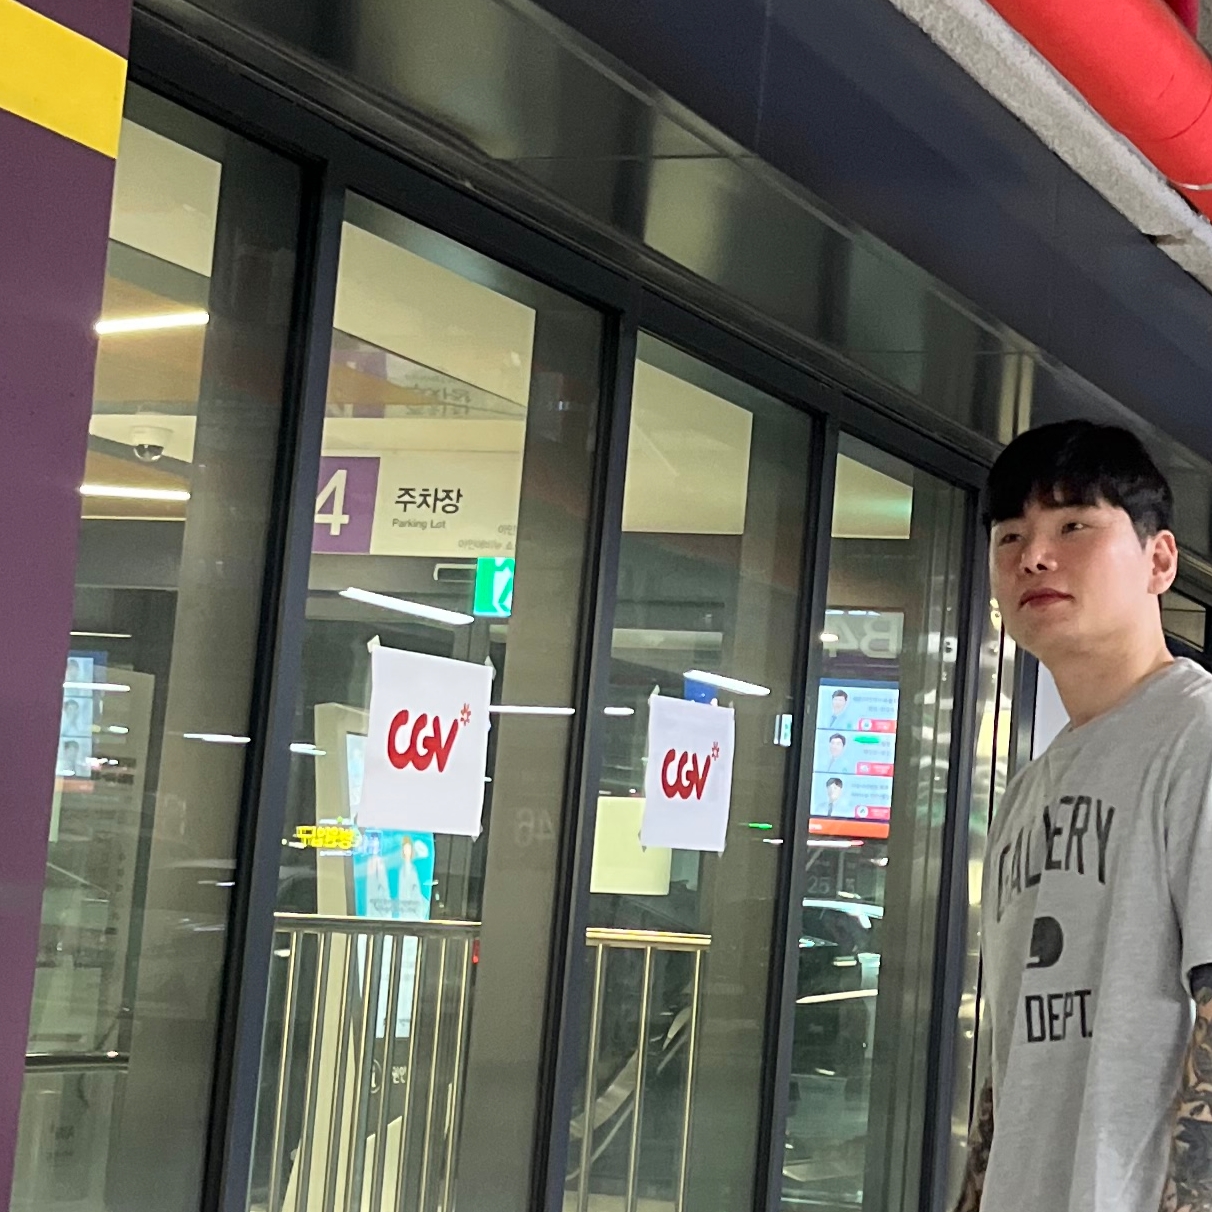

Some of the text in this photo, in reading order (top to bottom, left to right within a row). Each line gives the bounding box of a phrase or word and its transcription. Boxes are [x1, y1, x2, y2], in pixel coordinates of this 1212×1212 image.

[394, 487, 464, 515] 주차장
[392, 518, 446, 531] Parking Lot
[387, 709, 460, 773] CGV
[661, 748, 711, 801] CGV
